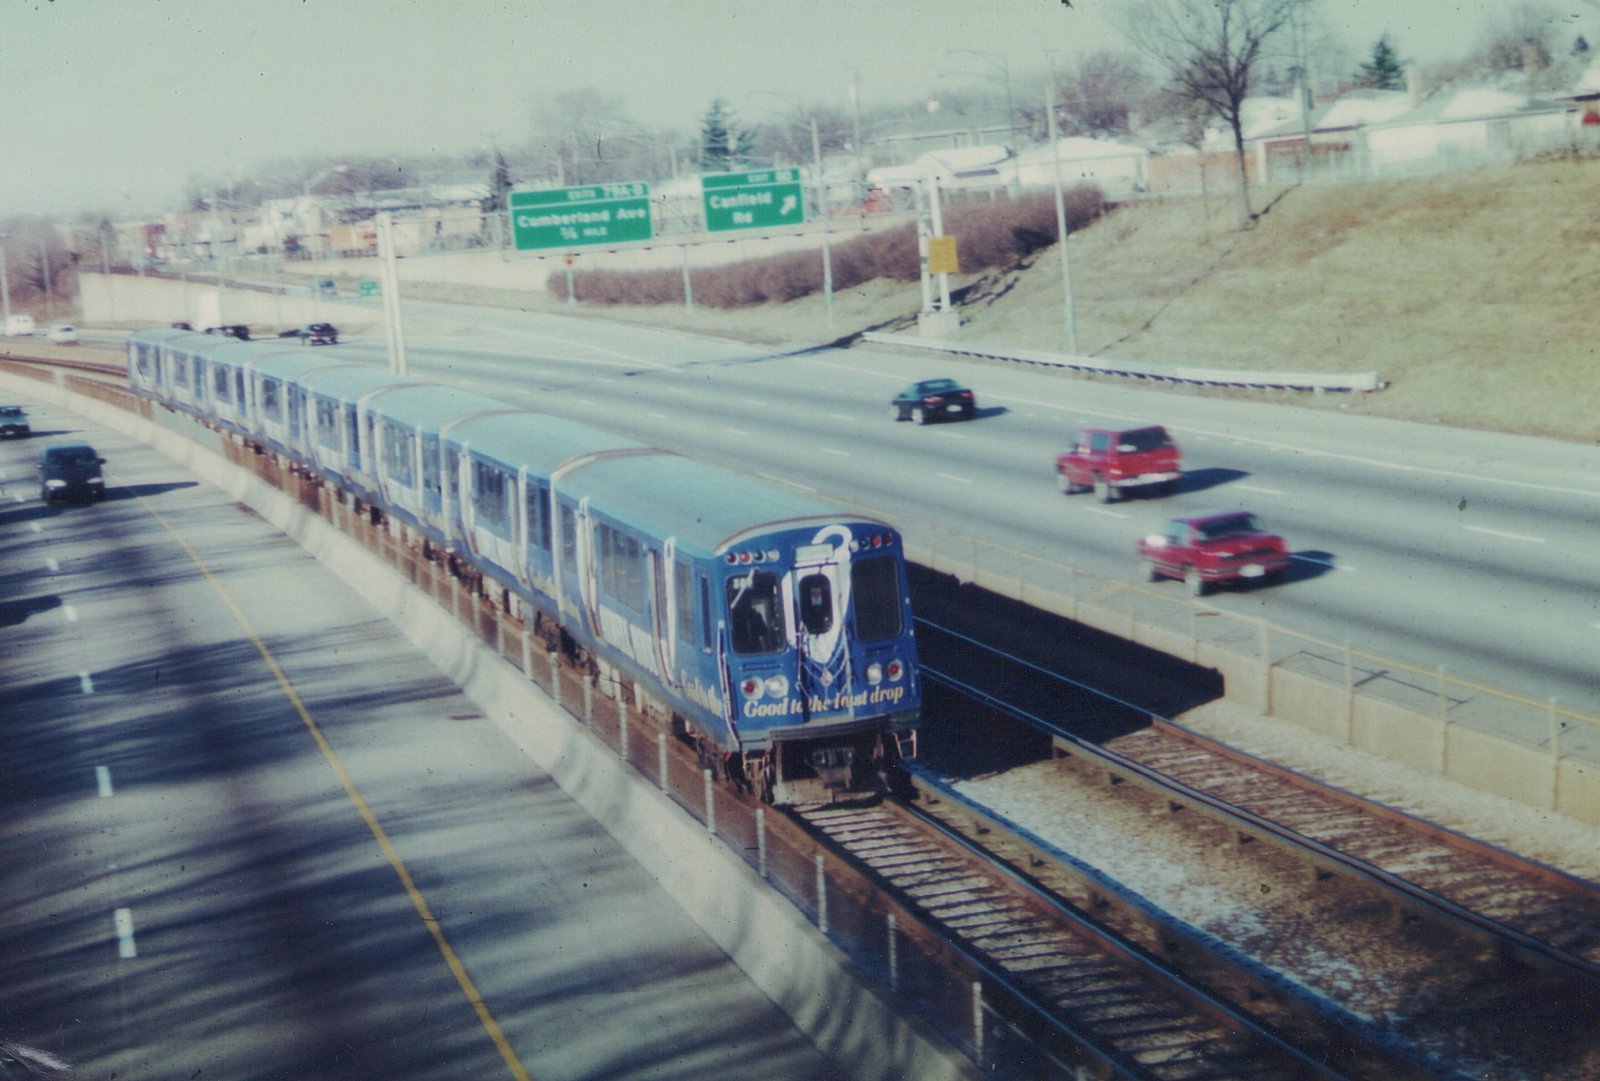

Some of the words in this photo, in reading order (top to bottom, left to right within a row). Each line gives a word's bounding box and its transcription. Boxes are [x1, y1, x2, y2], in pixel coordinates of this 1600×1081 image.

[709, 191, 773, 209] Canfield
[517, 209, 610, 228] Cumberland
[616, 207, 647, 220] Ave
[732, 211, 753, 224] Rd
[743, 697, 789, 718] Good
[870, 685, 904, 704] drop
